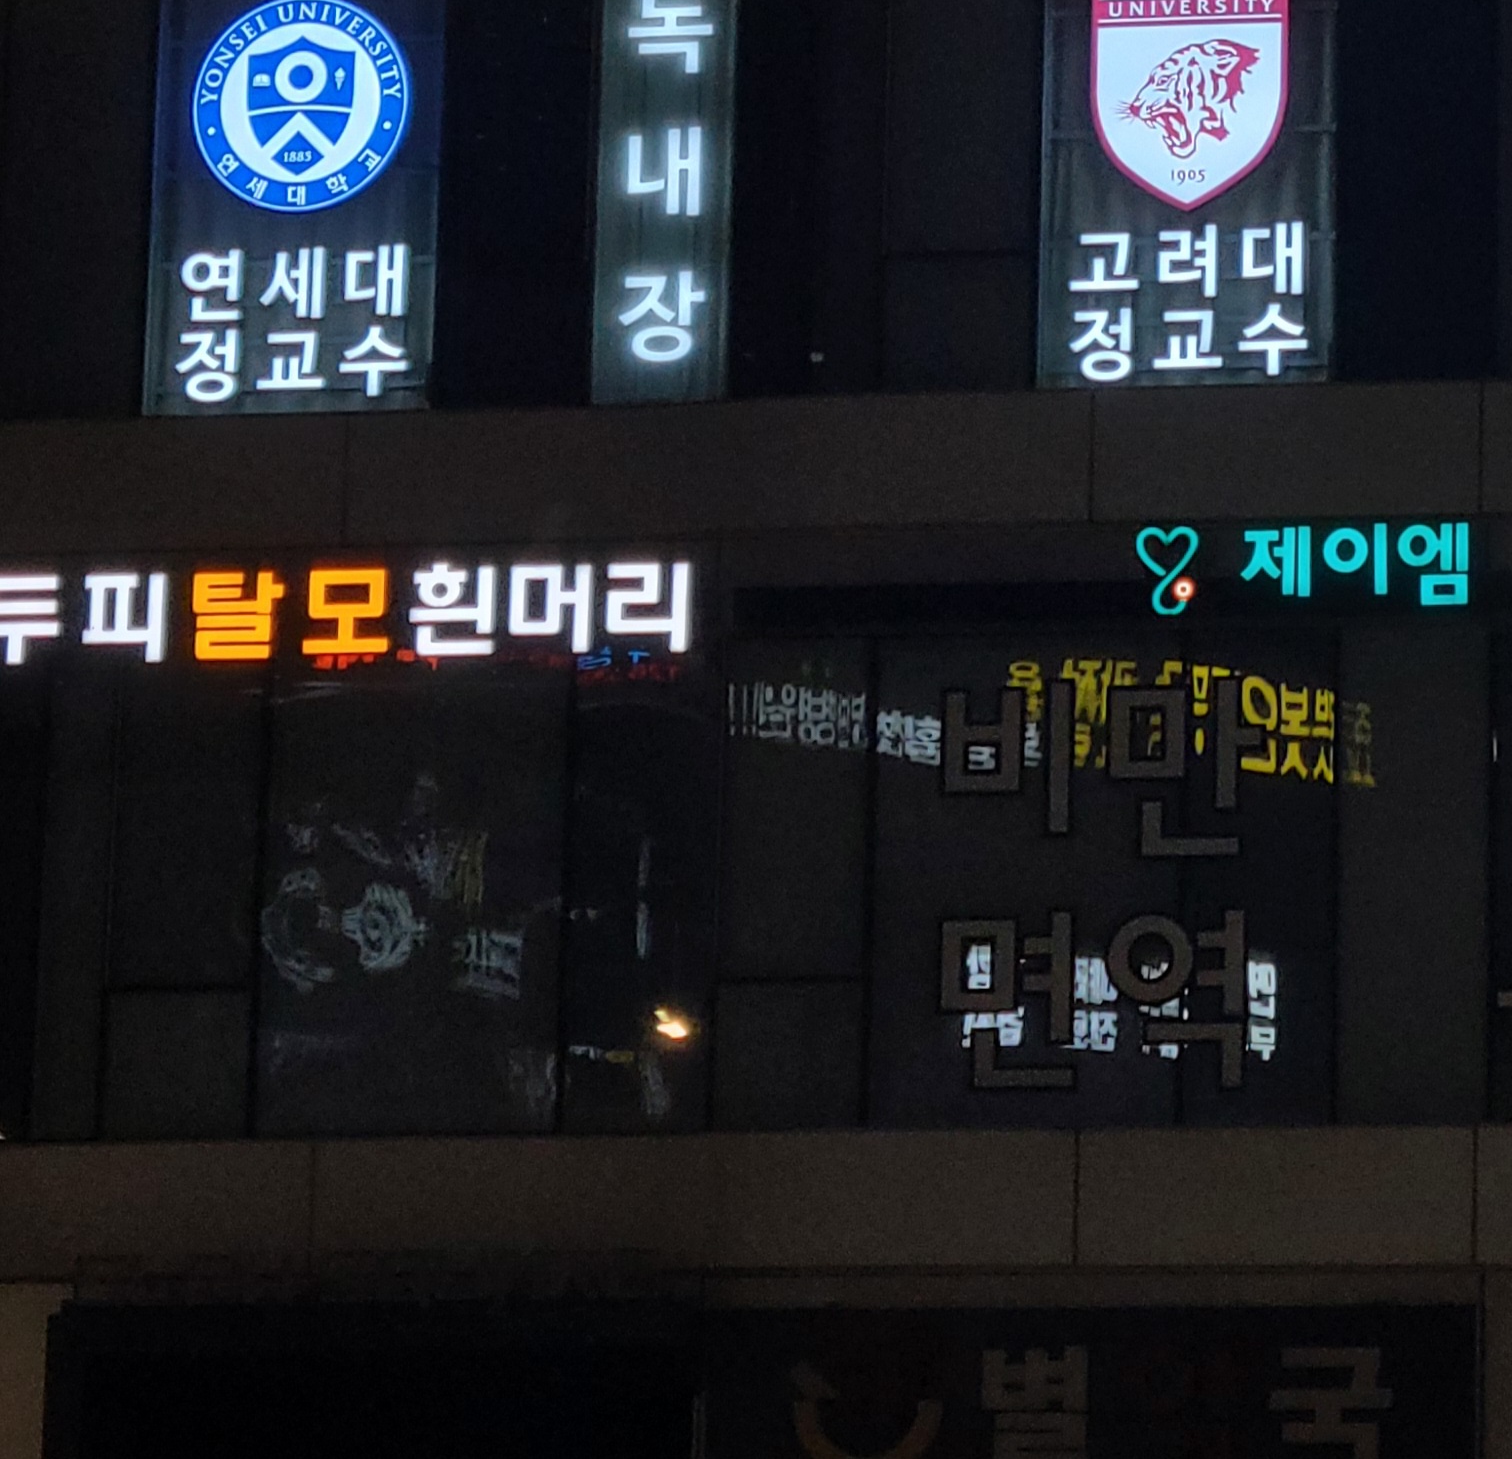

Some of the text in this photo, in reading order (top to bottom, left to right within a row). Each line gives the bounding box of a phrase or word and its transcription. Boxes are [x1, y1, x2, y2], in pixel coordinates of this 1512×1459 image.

[200, 1, 403, 105] YONSEI UNIVERSITY
[1169, 166, 1208, 187] 1905
[181, 243, 408, 323] 연세대
[1069, 222, 1304, 298] 고려대
[175, 325, 410, 403] 정교수
[1069, 303, 1309, 382] 정교수
[1240, 522, 1470, 606] 제이엠
[940, 678, 1239, 856] 비만
[940, 909, 1245, 1090] 면역
